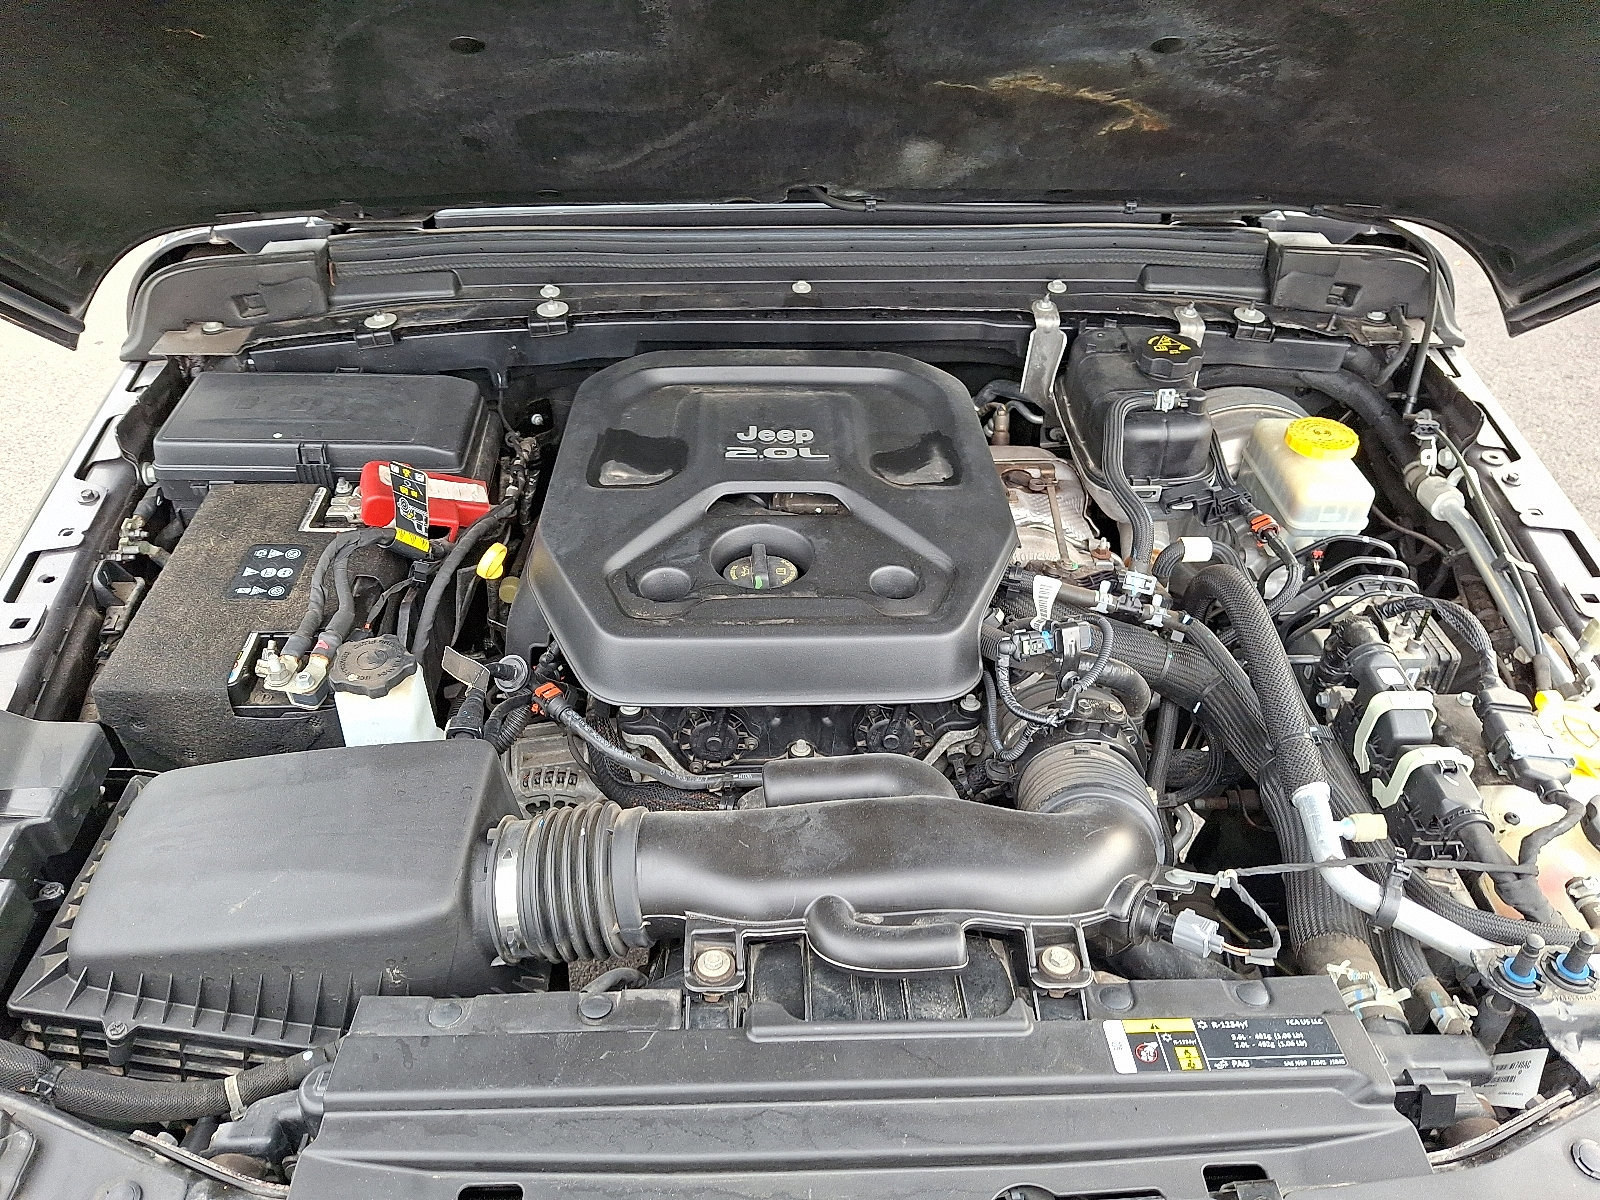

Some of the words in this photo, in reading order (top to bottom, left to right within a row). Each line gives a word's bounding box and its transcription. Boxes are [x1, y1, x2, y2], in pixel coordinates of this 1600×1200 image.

[736, 425, 815, 444] Jeep
[724, 446, 830, 461] 2.0L
[1231, 1059, 1250, 1068] PAG
